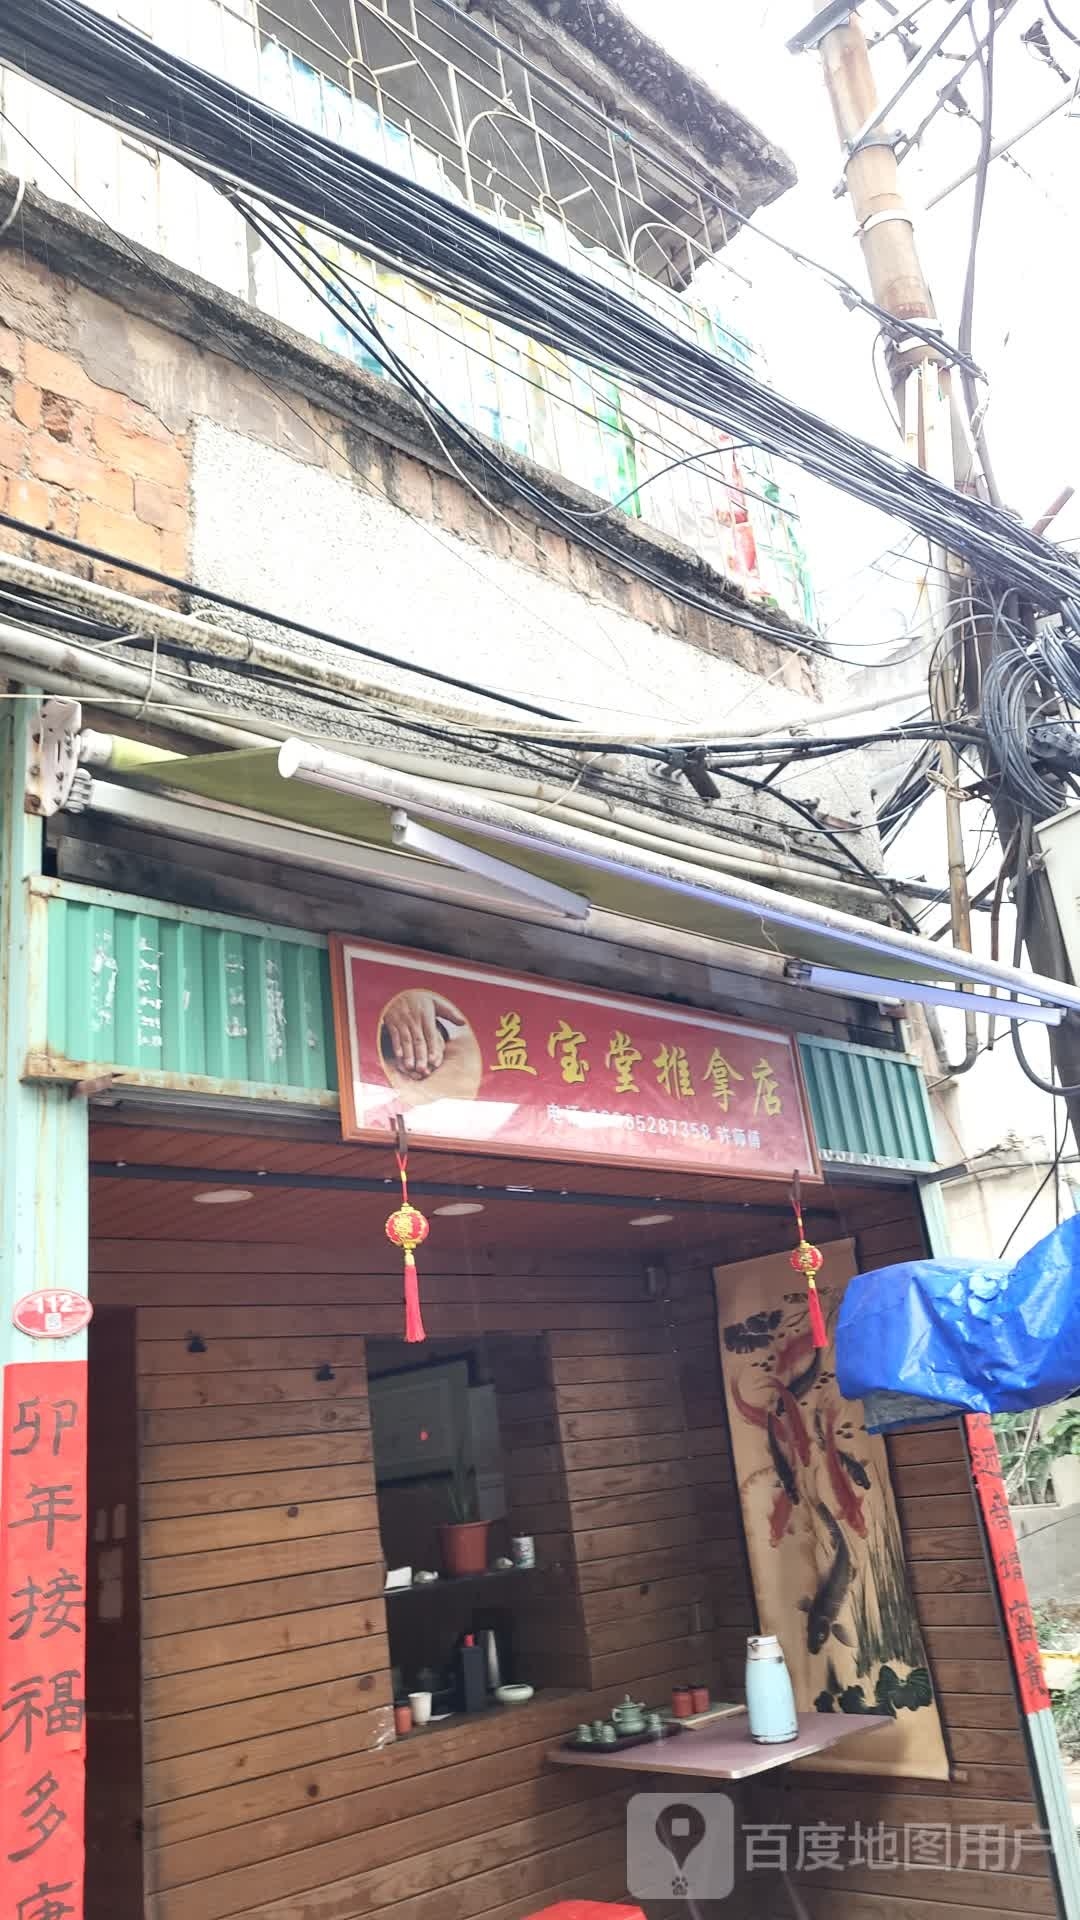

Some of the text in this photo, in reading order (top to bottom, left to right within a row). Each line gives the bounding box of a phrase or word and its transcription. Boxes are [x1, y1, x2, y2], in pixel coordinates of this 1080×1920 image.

[489, 1011, 781, 1116] 益宝堂推拿店
[588, 1109, 712, 1142] 65287358
[34, 1295, 73, 1313] 112
